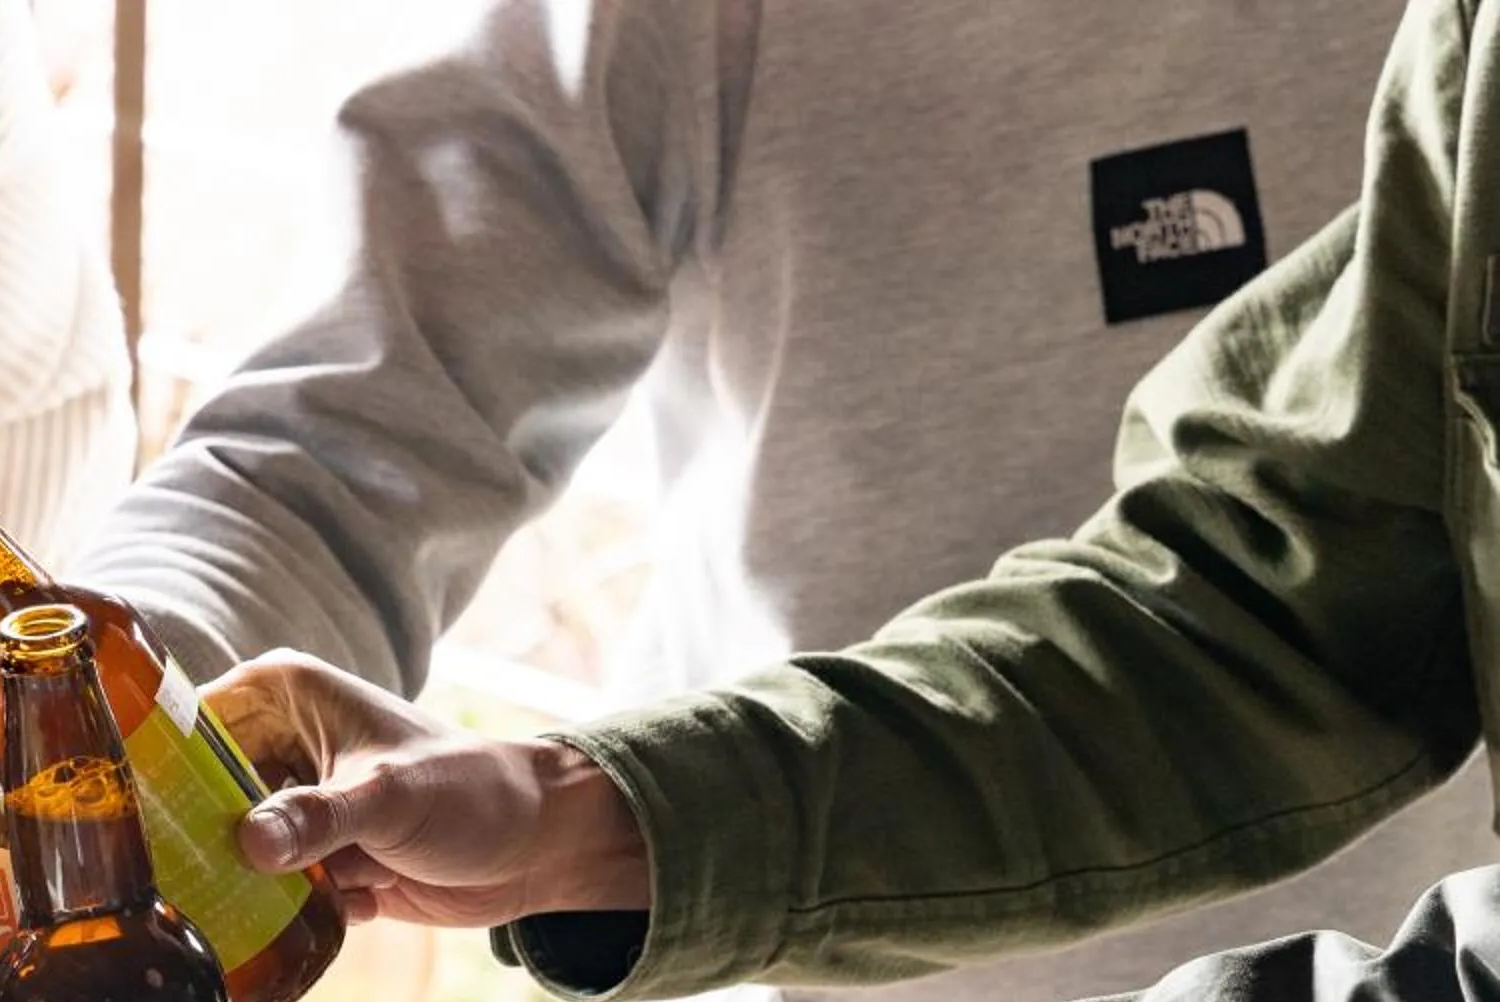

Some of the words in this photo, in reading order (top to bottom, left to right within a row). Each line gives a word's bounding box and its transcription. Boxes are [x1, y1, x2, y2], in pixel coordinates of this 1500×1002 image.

[1141, 192, 1193, 223] THE
[1110, 216, 1196, 250] NORTH
[1136, 234, 1198, 264] FACE
